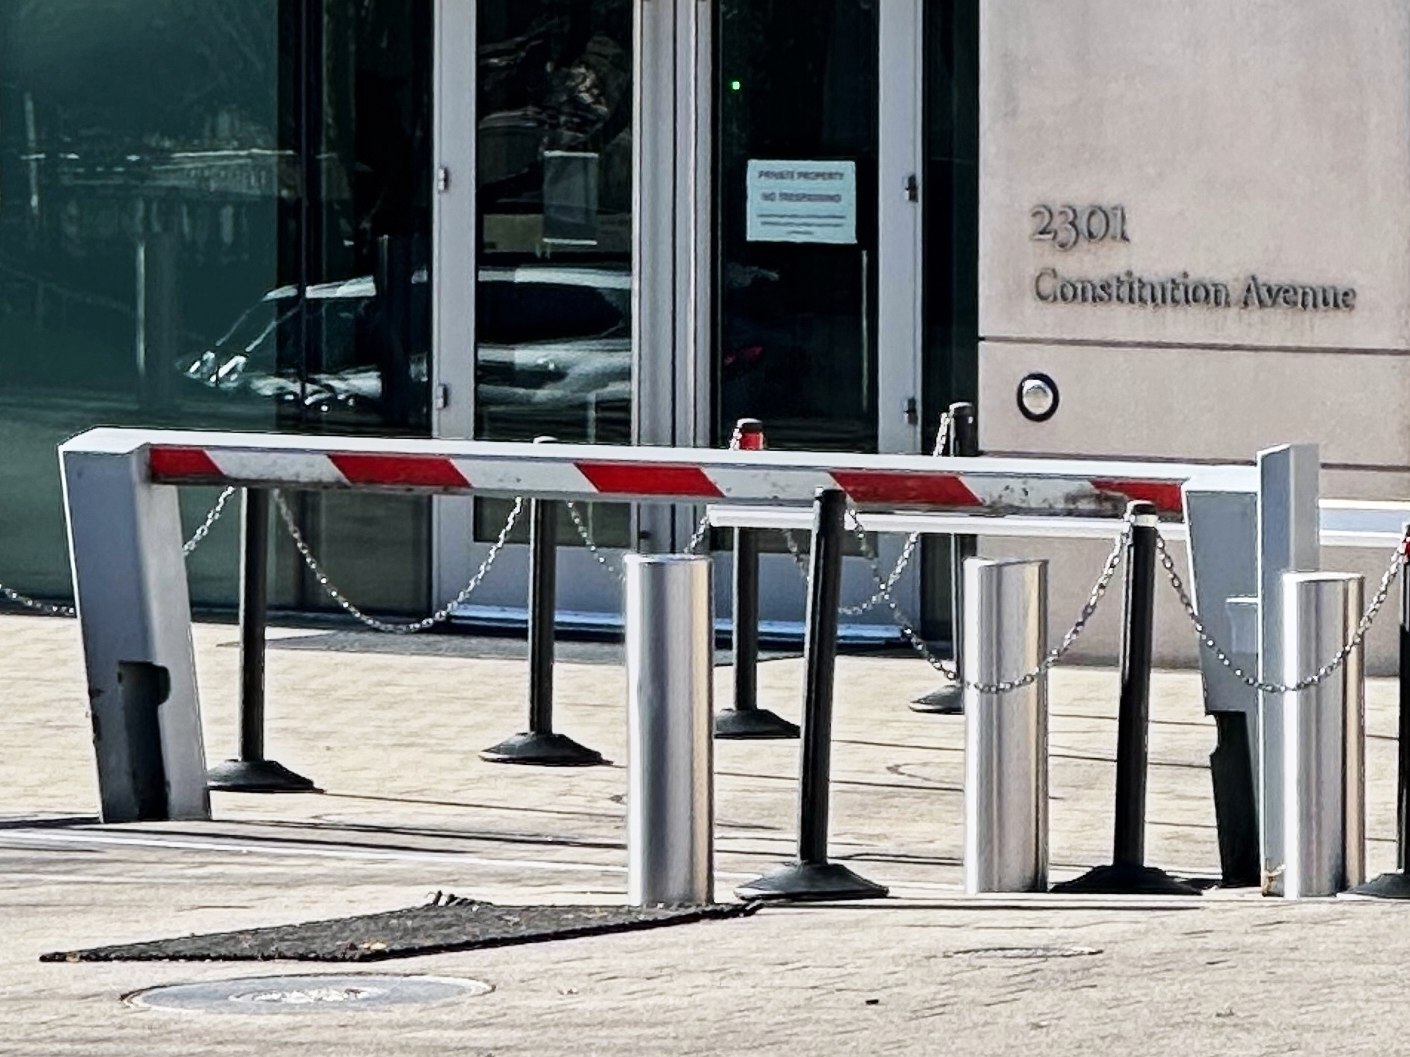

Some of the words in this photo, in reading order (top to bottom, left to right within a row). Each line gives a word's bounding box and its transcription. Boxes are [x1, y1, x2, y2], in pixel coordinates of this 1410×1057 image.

[1030, 203, 1131, 251] 2301
[1034, 267, 1232, 309] Constitution
[1240, 272, 1357, 312] Avenue
